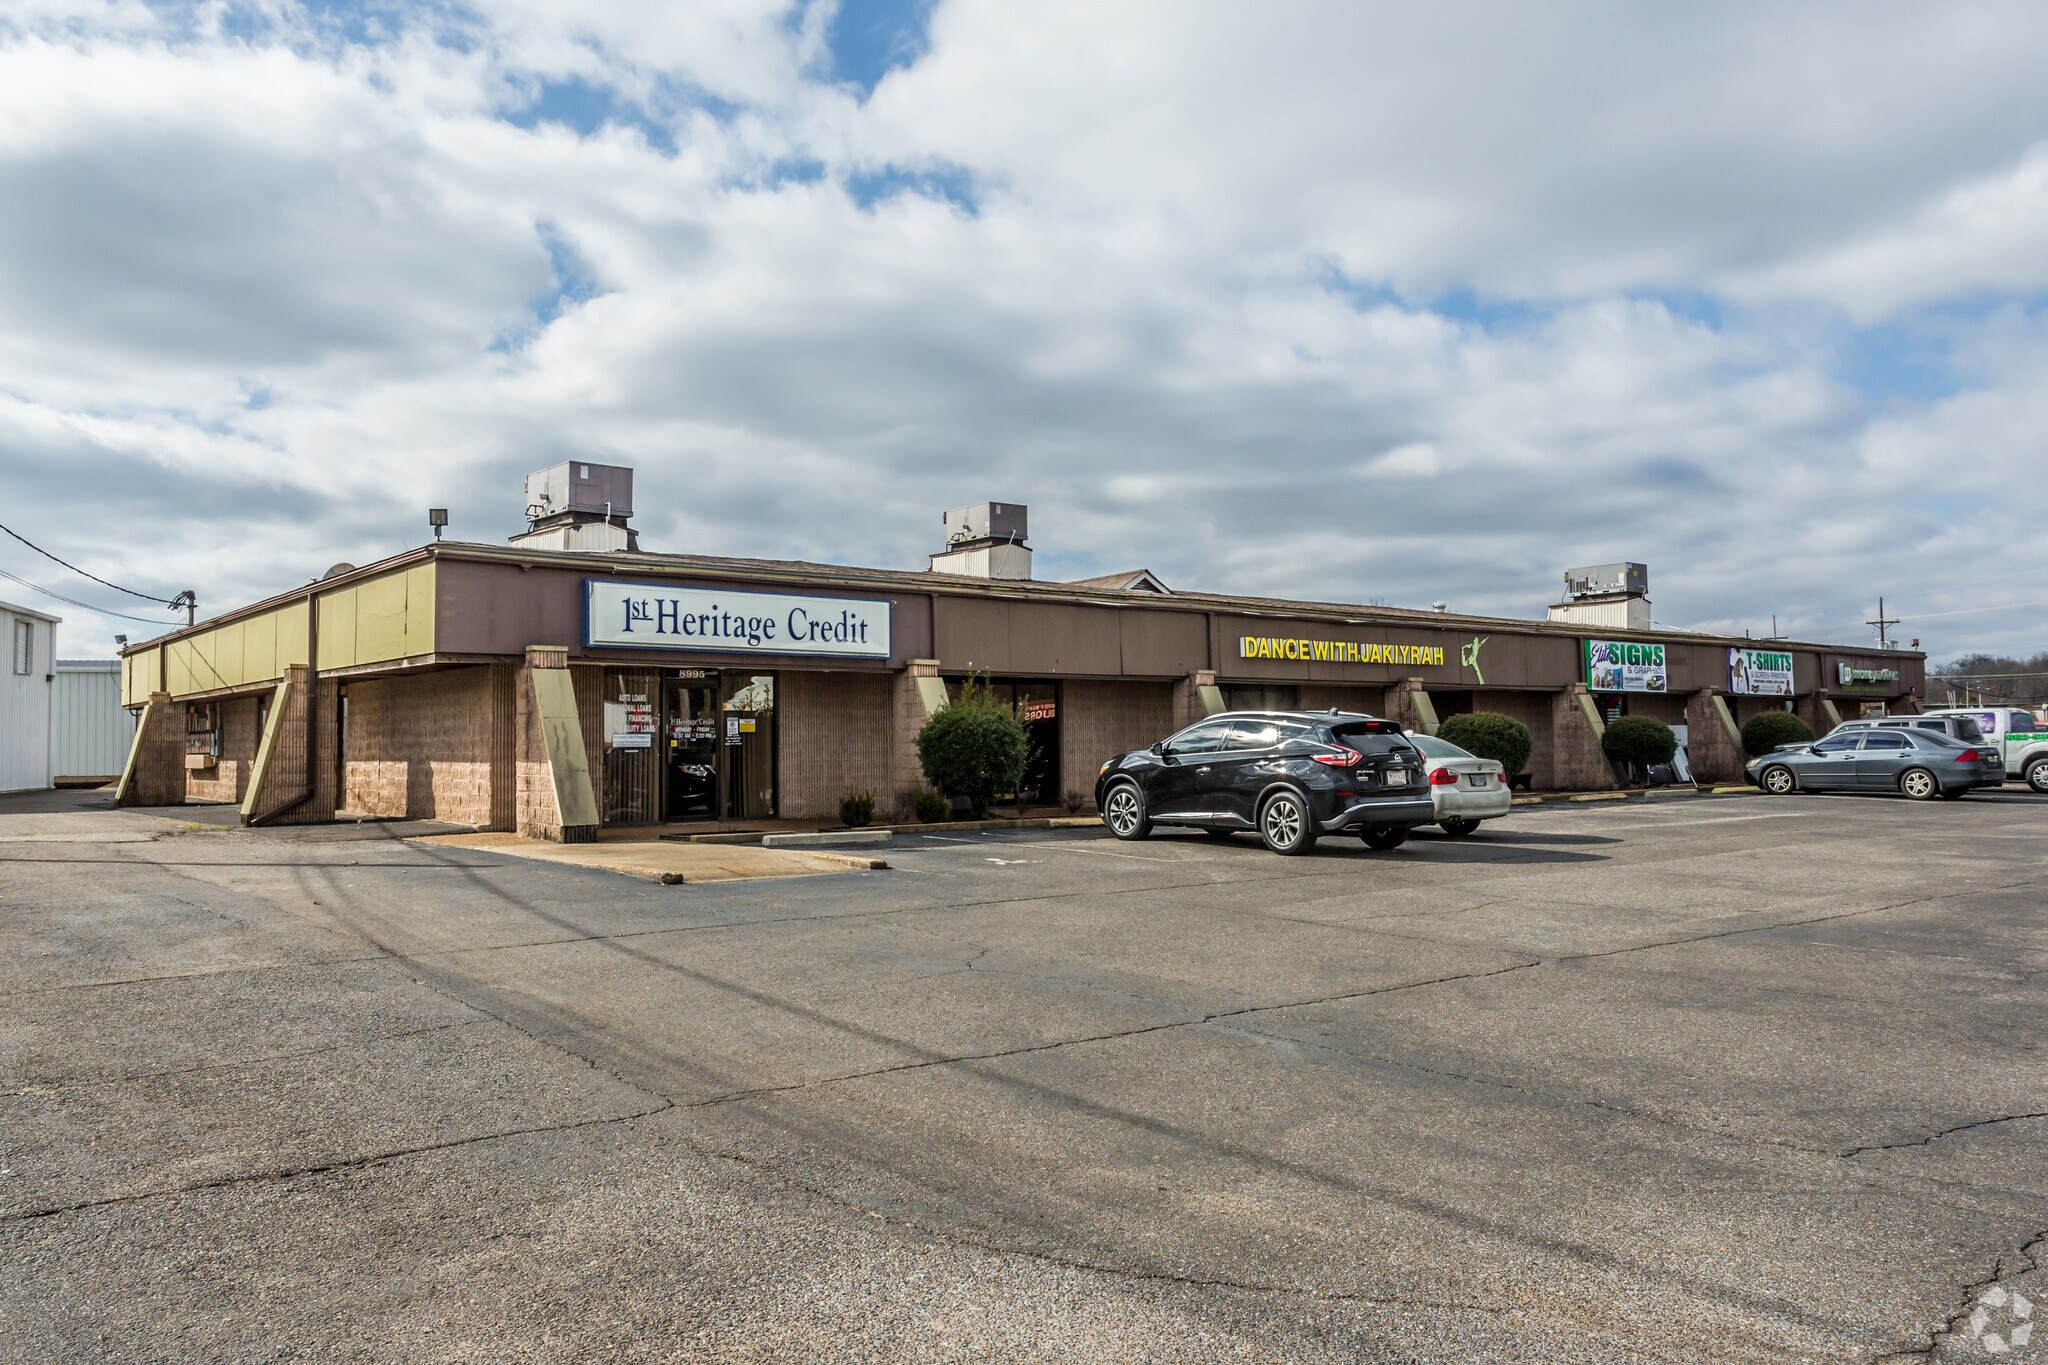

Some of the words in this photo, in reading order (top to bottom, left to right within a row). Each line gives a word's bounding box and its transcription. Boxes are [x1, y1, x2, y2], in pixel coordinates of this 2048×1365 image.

[622, 597, 653, 632] 1st
[655, 598, 776, 647] Heritage
[787, 607, 868, 644] Credit
[1241, 636, 1310, 660] DANCE
[1312, 640, 1358, 662] WITH
[1360, 644, 1444, 665] JAKIYRAH
[1588, 644, 1609, 668] Elite
[1608, 643, 1664, 666] SIGNS
[1746, 651, 1791, 672] T-SHIRTS
[679, 669, 705, 678] 8995
[1634, 666, 1664, 675] GRAPHICS
[1755, 671, 1770, 679] SCREEN
[1771, 672, 1789, 680] PRINTING
[676, 718, 698, 726] Heritage
